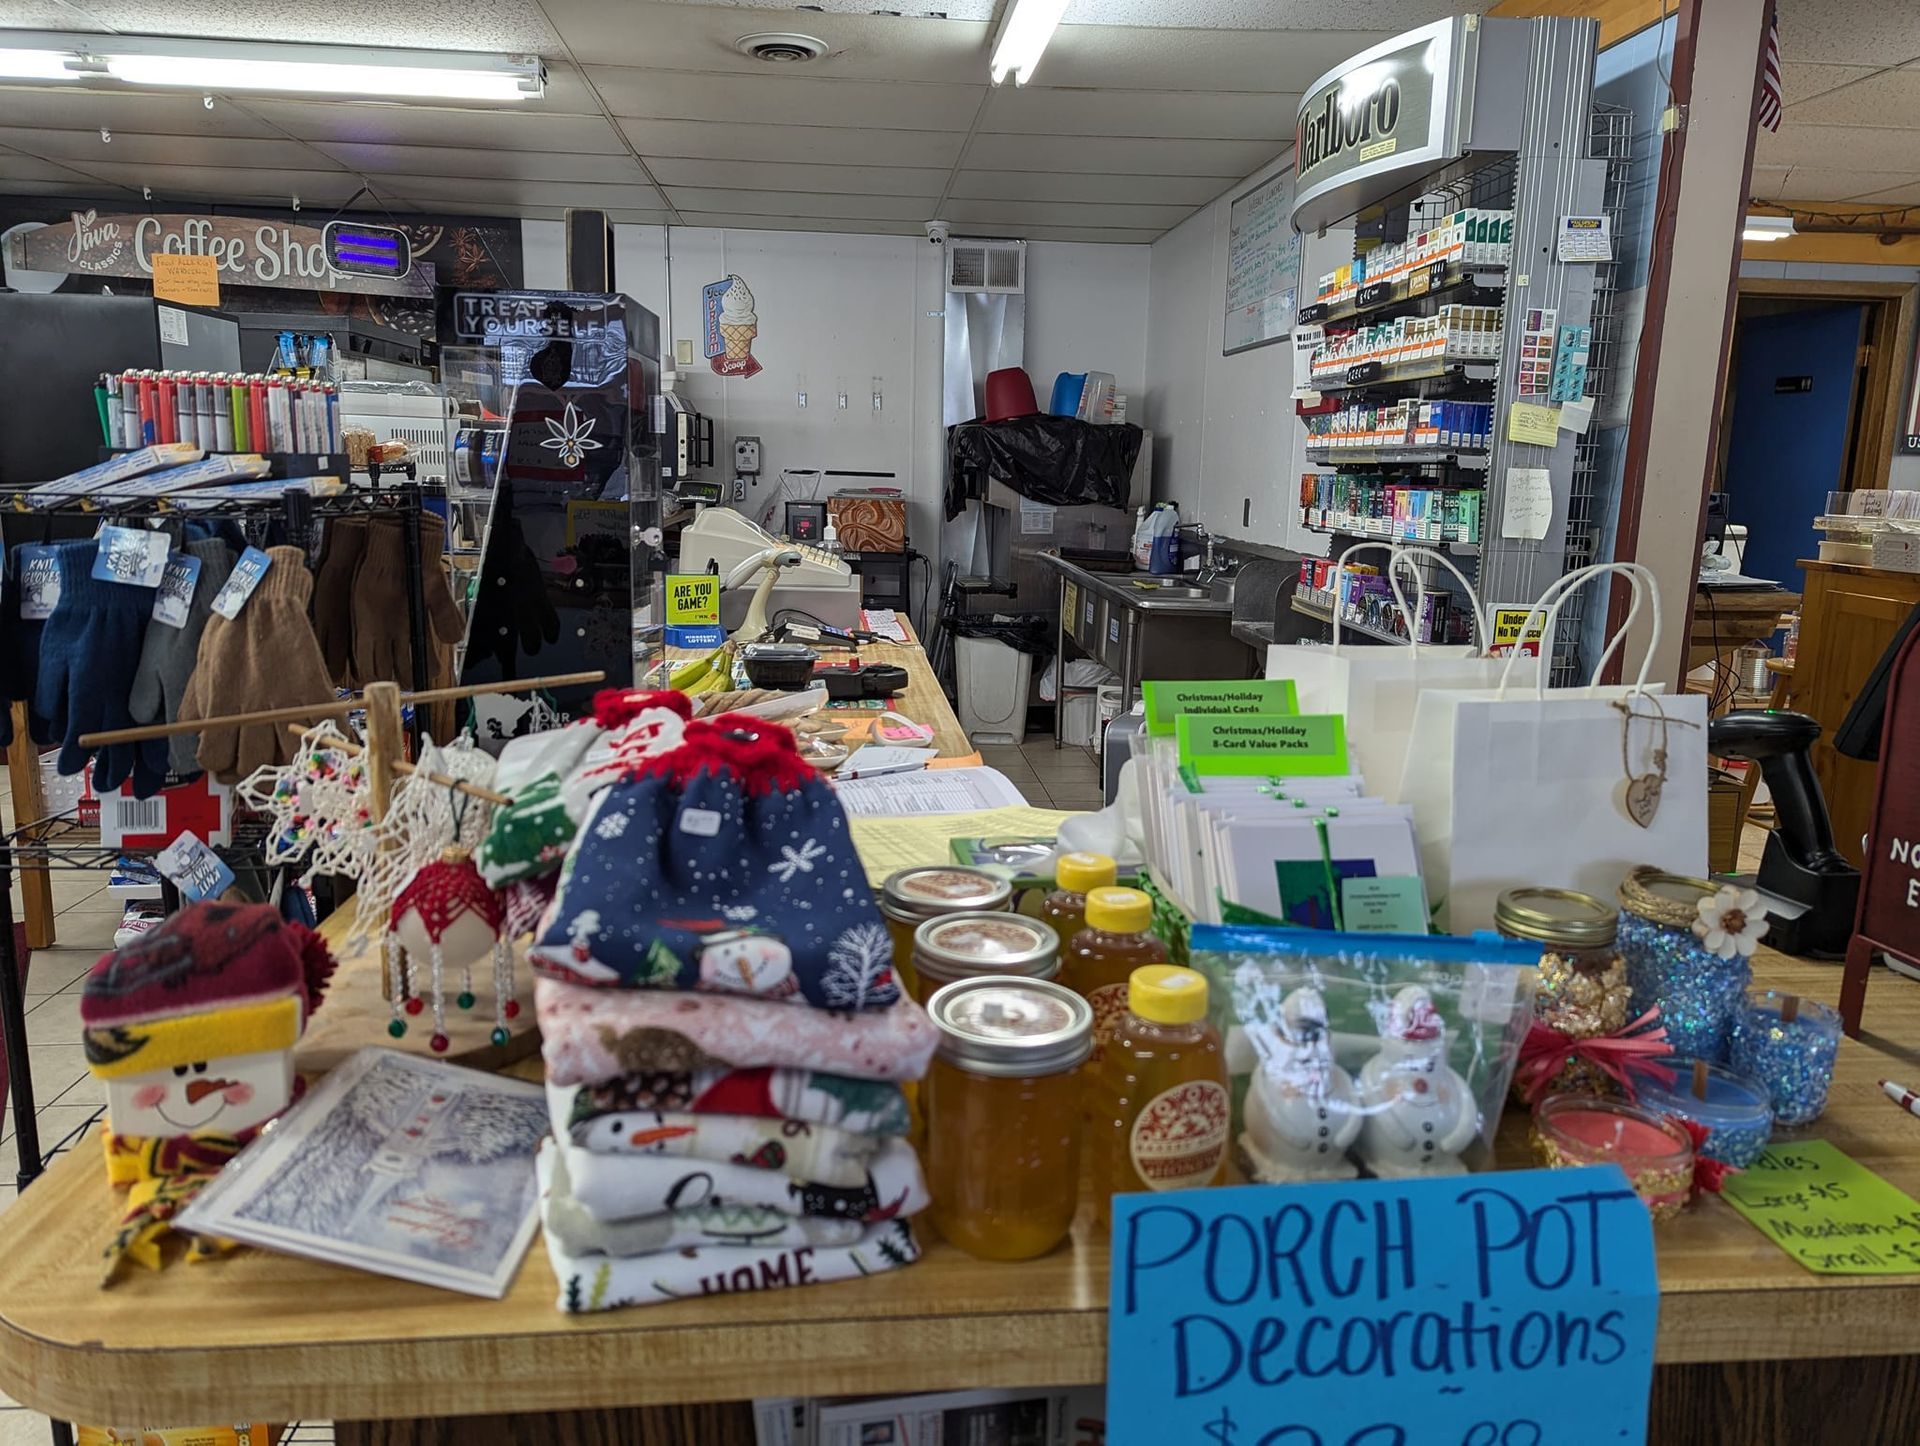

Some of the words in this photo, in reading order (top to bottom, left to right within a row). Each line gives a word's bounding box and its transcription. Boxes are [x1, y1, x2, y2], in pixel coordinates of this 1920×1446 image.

[68, 213, 119, 263] Java
[135, 217, 245, 273] Coffee
[80, 241, 123, 271] CLASSICS
[463, 299, 546, 317] TREAT
[464, 315, 600, 338] YOURSELF
[709, 299, 719, 353] CREAM
[722, 360, 746, 373] Scoop
[29, 558, 55, 571] KNIT
[166, 563, 192, 578] KNIT
[23, 571, 60, 586] GLOVES
[674, 585, 691, 599] ARE
[694, 583, 712, 596] YOU
[677, 596, 708, 611] GAME?
[1503, 614, 1528, 625] Under
[1498, 627, 1508, 637] No
[1176, 692, 1263, 702] Christmas/Holiday
[1183, 705, 1231, 714] Individual
[1233, 705, 1260, 713] Cards
[1212, 726, 1307, 737] Christmas/Holiday
[1213, 740, 1246, 748] 8-Card
[1249, 740, 1277, 748] Value
[1280, 740, 1309, 748] Packs
[191, 862, 211, 886] HAT
[199, 869, 221, 898] KNIT
[1125, 1198, 1415, 1314] PORCH
[1456, 1187, 1640, 1298] POT
[699, 1246, 818, 1294] HOME
[1172, 1302, 1627, 1398] Decorations
